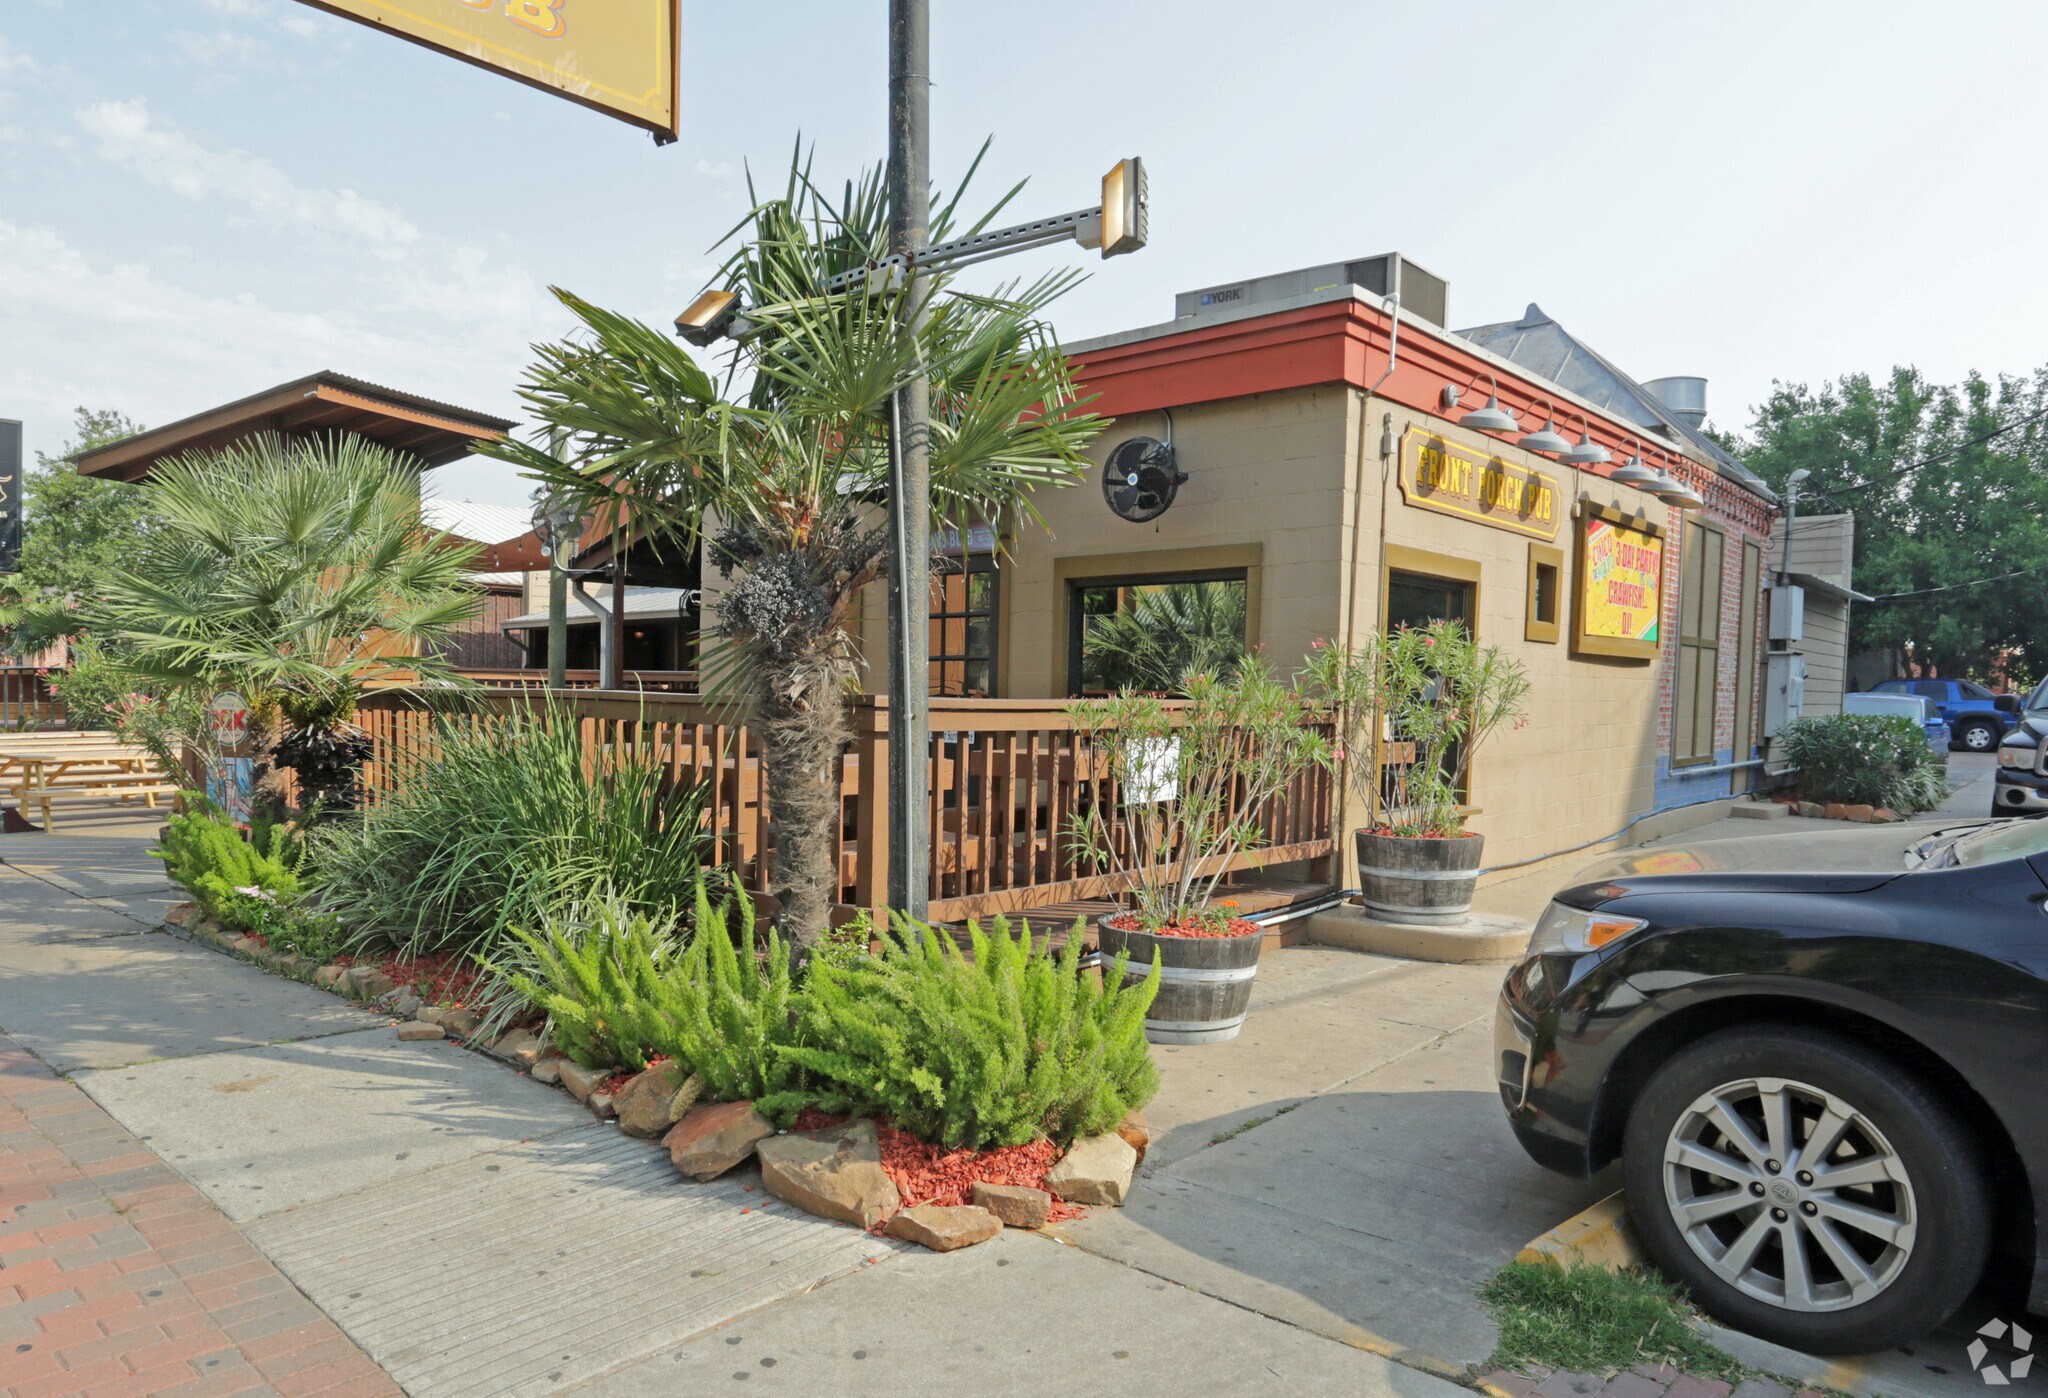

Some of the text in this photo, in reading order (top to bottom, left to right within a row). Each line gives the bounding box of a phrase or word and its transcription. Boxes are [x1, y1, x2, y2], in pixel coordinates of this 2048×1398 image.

[1211, 288, 1241, 304] YORK
[1416, 442, 1552, 524] FRONT PORCH PUB
[949, 528, 973, 547] BLD
[1608, 579, 1646, 609] CRAWFISH!
